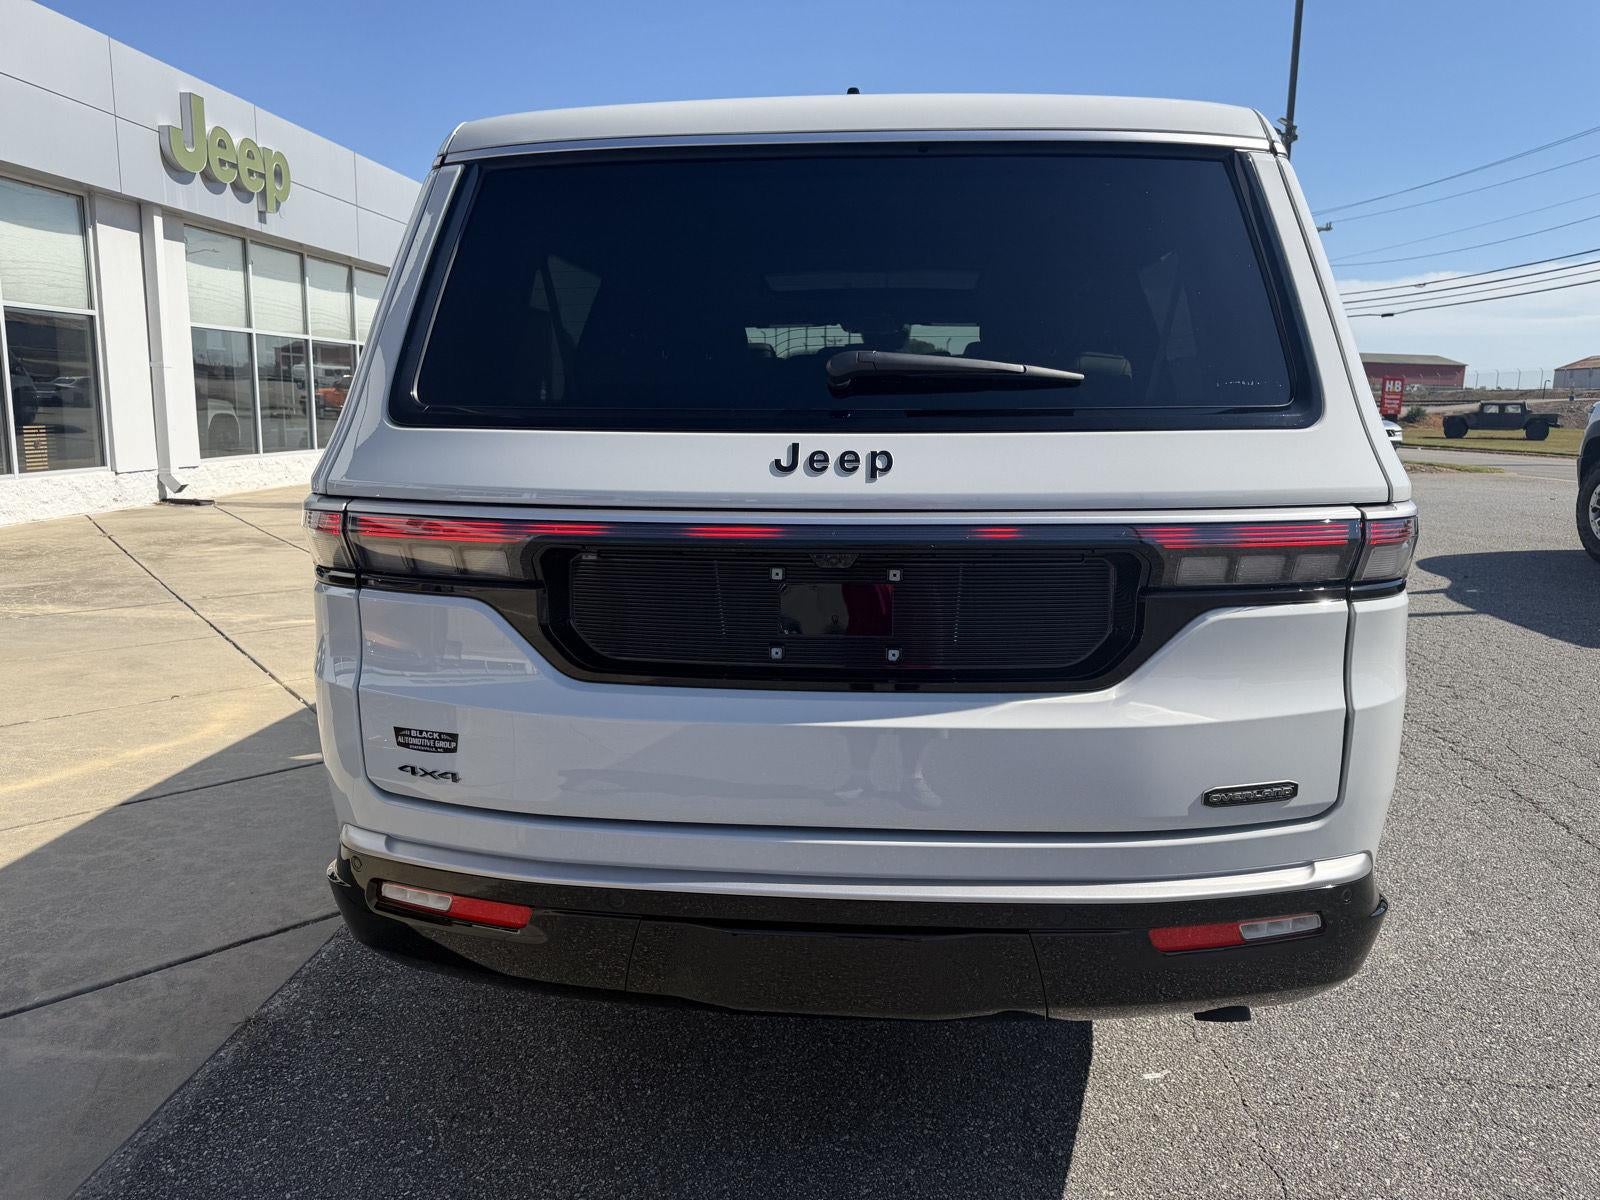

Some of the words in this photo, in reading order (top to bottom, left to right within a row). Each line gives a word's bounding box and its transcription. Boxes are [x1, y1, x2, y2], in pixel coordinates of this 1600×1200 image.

[158, 91, 291, 214] Jeep
[774, 442, 894, 479] Jeep
[398, 735, 435, 747] AUTOMOTIVE
[435, 740, 456, 749] GROUP
[411, 729, 440, 739] BLACK
[1209, 785, 1295, 802] OVERLAND
